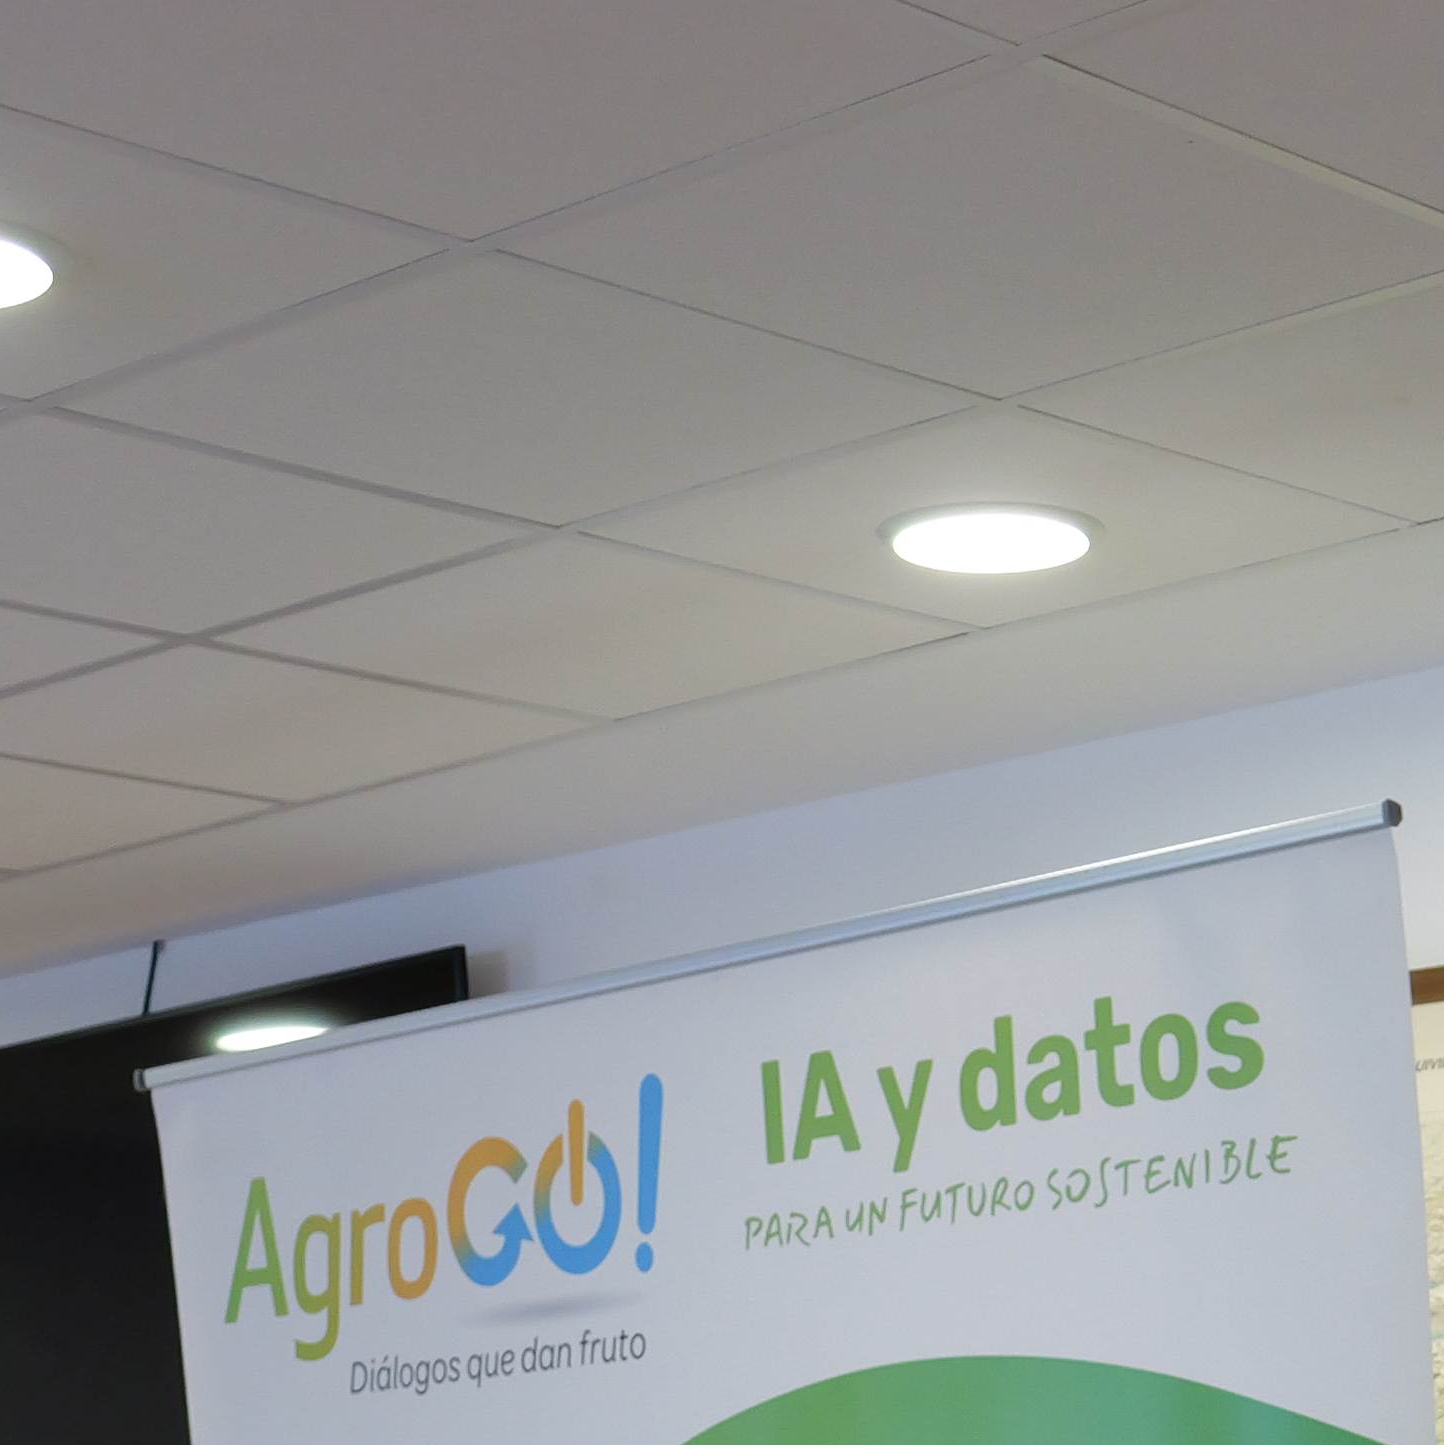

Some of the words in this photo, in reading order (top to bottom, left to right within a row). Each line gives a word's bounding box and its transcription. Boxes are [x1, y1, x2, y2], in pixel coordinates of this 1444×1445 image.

[761, 1050, 861, 1164] IA
[876, 1058, 933, 1173] y
[959, 996, 1264, 1132] datos
[744, 1205, 834, 1250] PARA
[845, 1197, 888, 1236] UN
[899, 1176, 1035, 1232] FUTURO
[1047, 1134, 1298, 1209] SOSTENIBLE
[350, 1354, 461, 1395] Diálogos
[467, 1348, 515, 1388] que
[521, 1337, 572, 1374] dan
[579, 1329, 647, 1367] fruto
